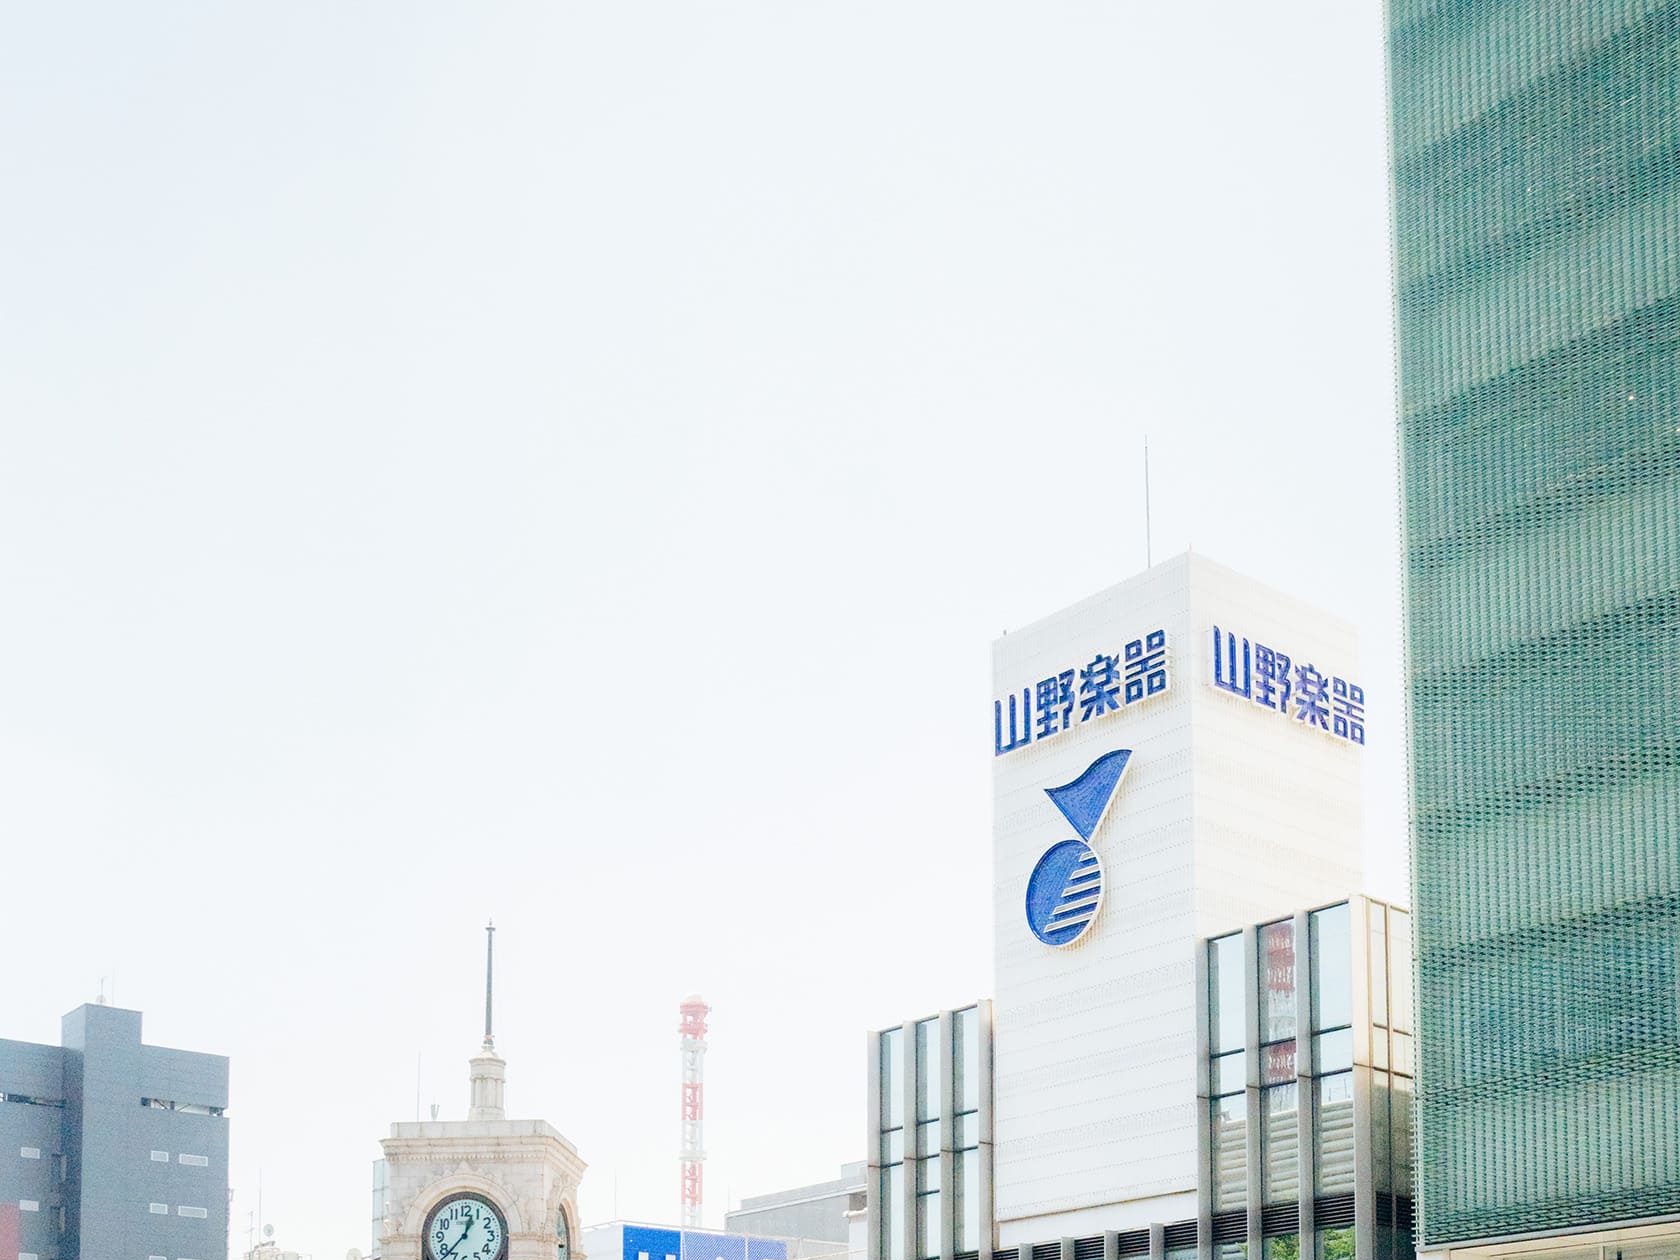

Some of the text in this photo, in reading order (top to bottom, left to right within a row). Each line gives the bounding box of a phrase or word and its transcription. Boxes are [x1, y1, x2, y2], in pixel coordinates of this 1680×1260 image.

[1212, 624, 1366, 747] 山野楽器
[994, 629, 1168, 758] 山野楽器
[450, 1208, 458, 1220] 11
[460, 1205, 472, 1217] 12
[440, 1218, 450, 1230] 10
[483, 1217, 492, 1229] 2
[436, 1231, 445, 1243] 9
[487, 1230, 495, 1242] 3
[440, 1243, 449, 1256] 8
[482, 1243, 491, 1255] 4
